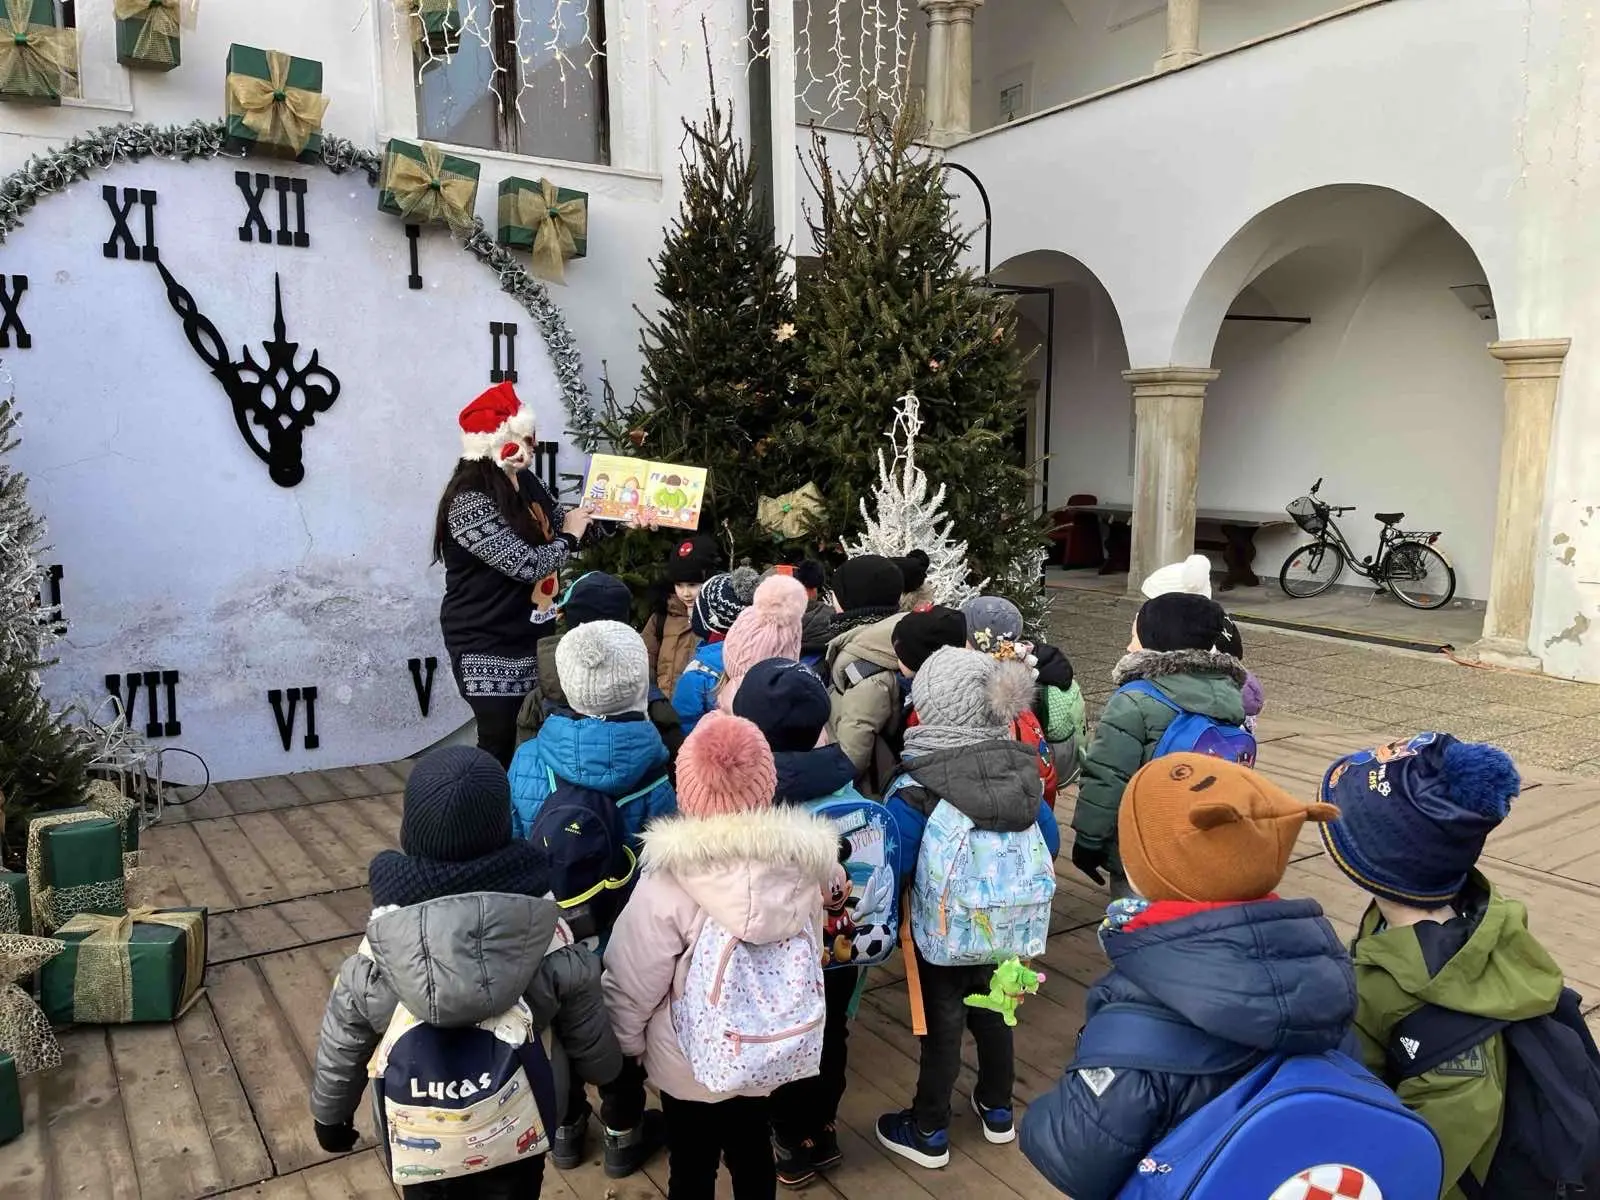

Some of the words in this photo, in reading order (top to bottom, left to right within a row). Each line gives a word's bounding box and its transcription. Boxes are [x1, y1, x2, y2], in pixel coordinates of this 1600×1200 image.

[103, 185, 158, 261] XI
[235, 171, 310, 247] XII
[490, 321, 518, 383] II
[105, 671, 181, 738] VII
[268, 686, 319, 751] VI
[408, 657, 438, 718] V
